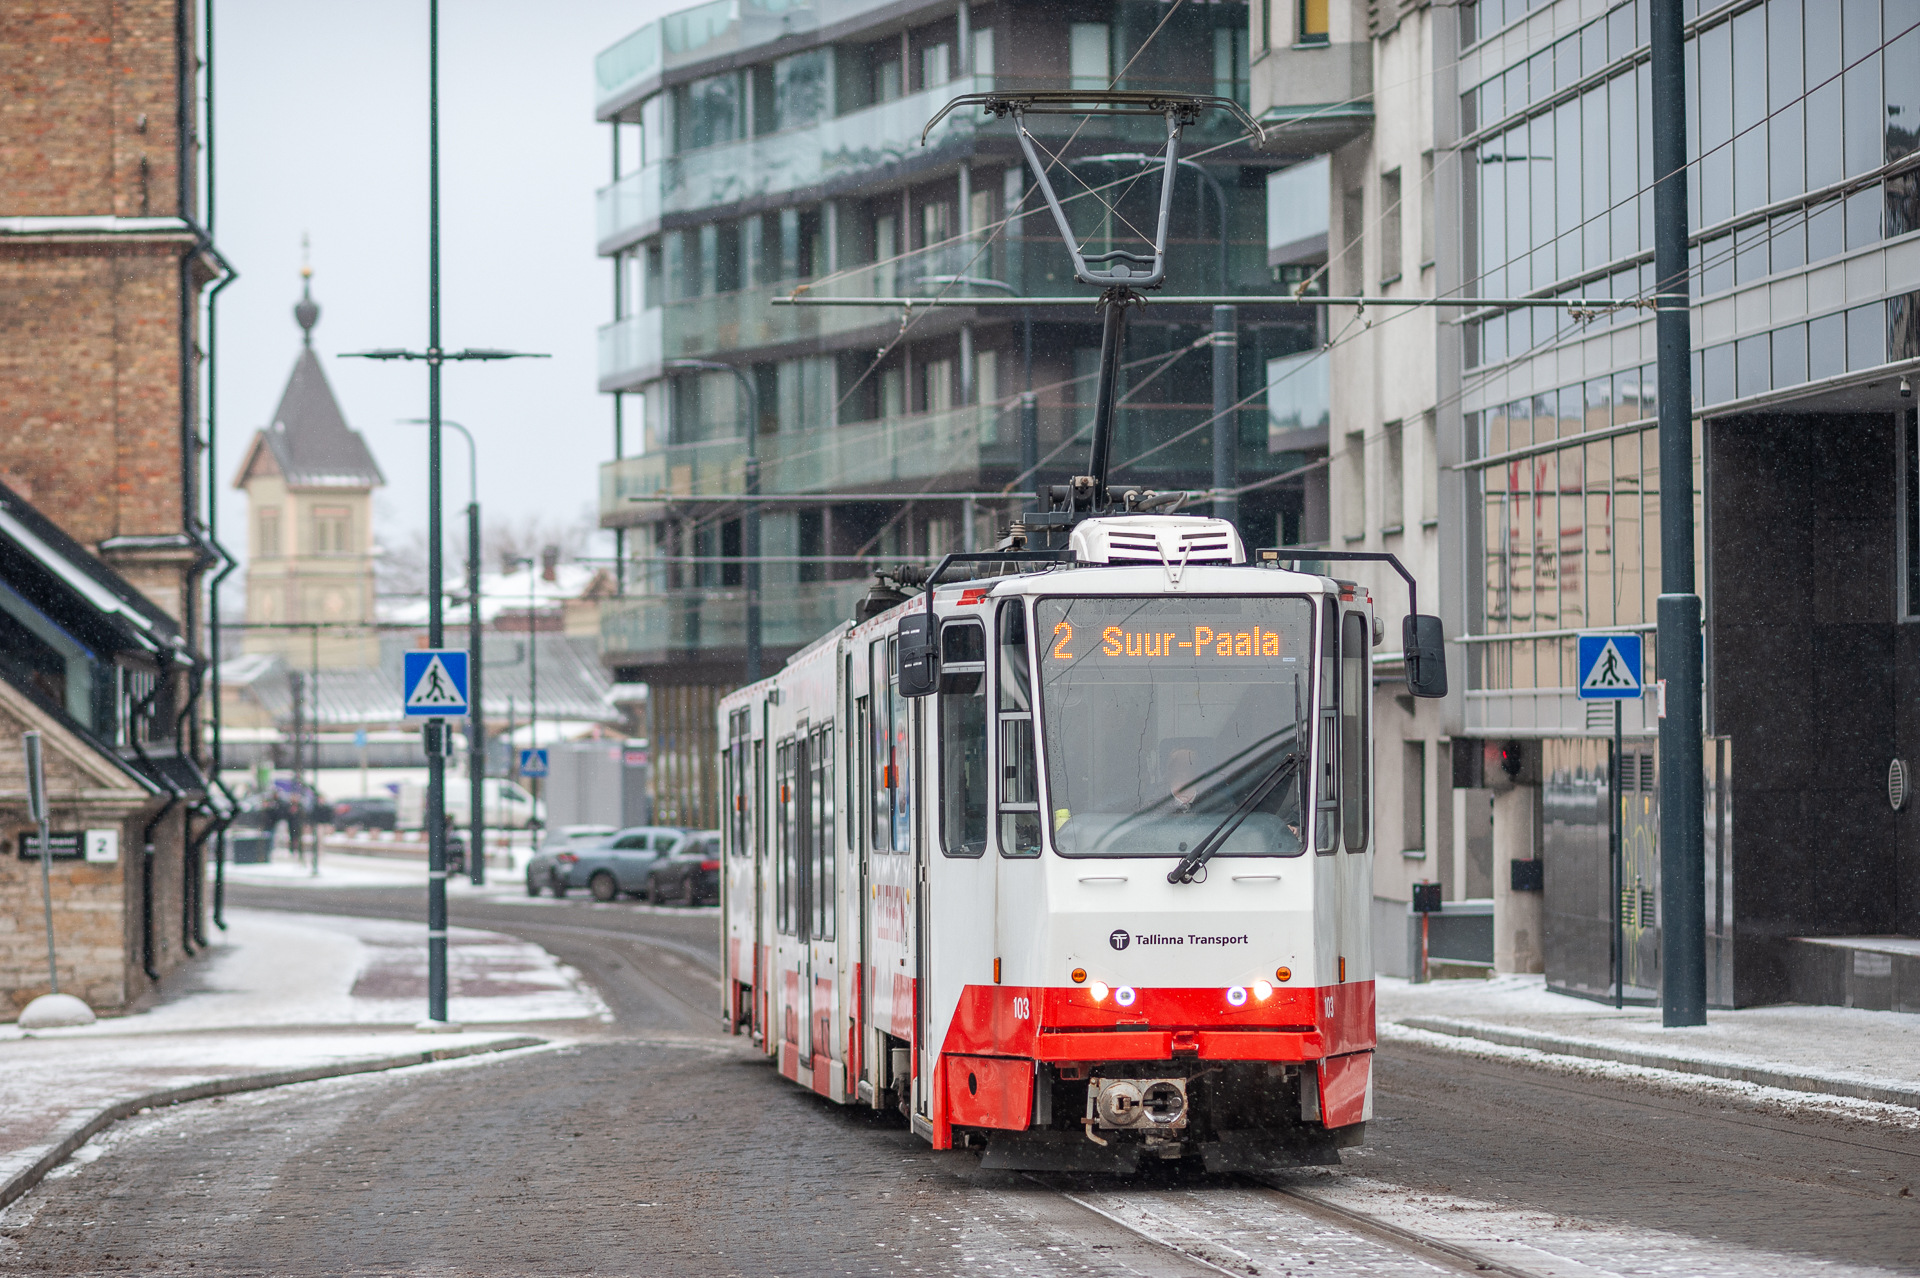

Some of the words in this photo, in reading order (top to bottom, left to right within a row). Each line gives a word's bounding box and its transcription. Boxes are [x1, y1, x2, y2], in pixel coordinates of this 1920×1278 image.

[1054, 622, 1073, 659] 2
[1102, 626, 1279, 656] Suur-Paala
[97, 838, 107, 853] 2
[1135, 934, 1184, 945] Tallinna
[1188, 934, 1248, 946] Transport
[1013, 996, 1030, 1020] 103
[1324, 995, 1335, 1019] 103
